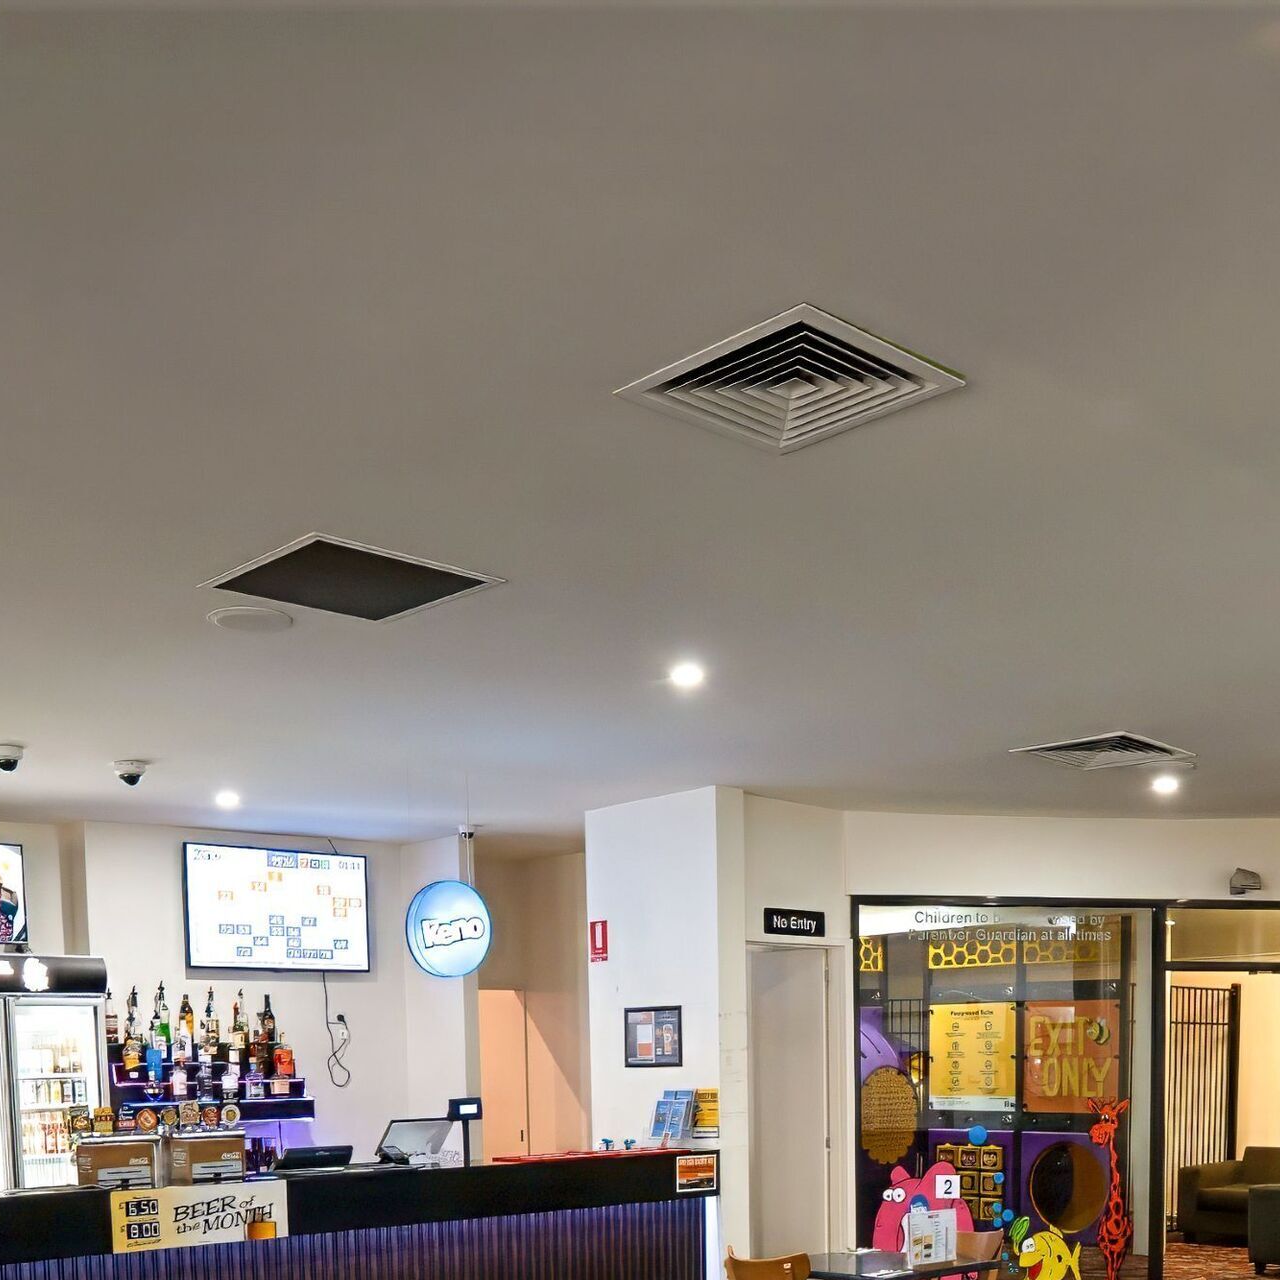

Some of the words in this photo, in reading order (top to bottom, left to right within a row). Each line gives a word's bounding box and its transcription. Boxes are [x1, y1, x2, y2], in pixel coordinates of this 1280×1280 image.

[773, 915, 787, 928] No
[791, 917, 816, 933] Entry
[914, 911, 972, 924] Children
[975, 912, 988, 923] to
[976, 928, 1036, 941] Guardian
[1041, 929, 1053, 941] at
[1077, 928, 1112, 941] times
[1029, 1015, 1091, 1057] EXIT
[1042, 1056, 1112, 1098] ONLY
[944, 1179, 953, 1195] 2
[172, 1195, 236, 1222] BEER
[176, 1222, 200, 1235] the
[202, 1203, 274, 1235] MONTH
